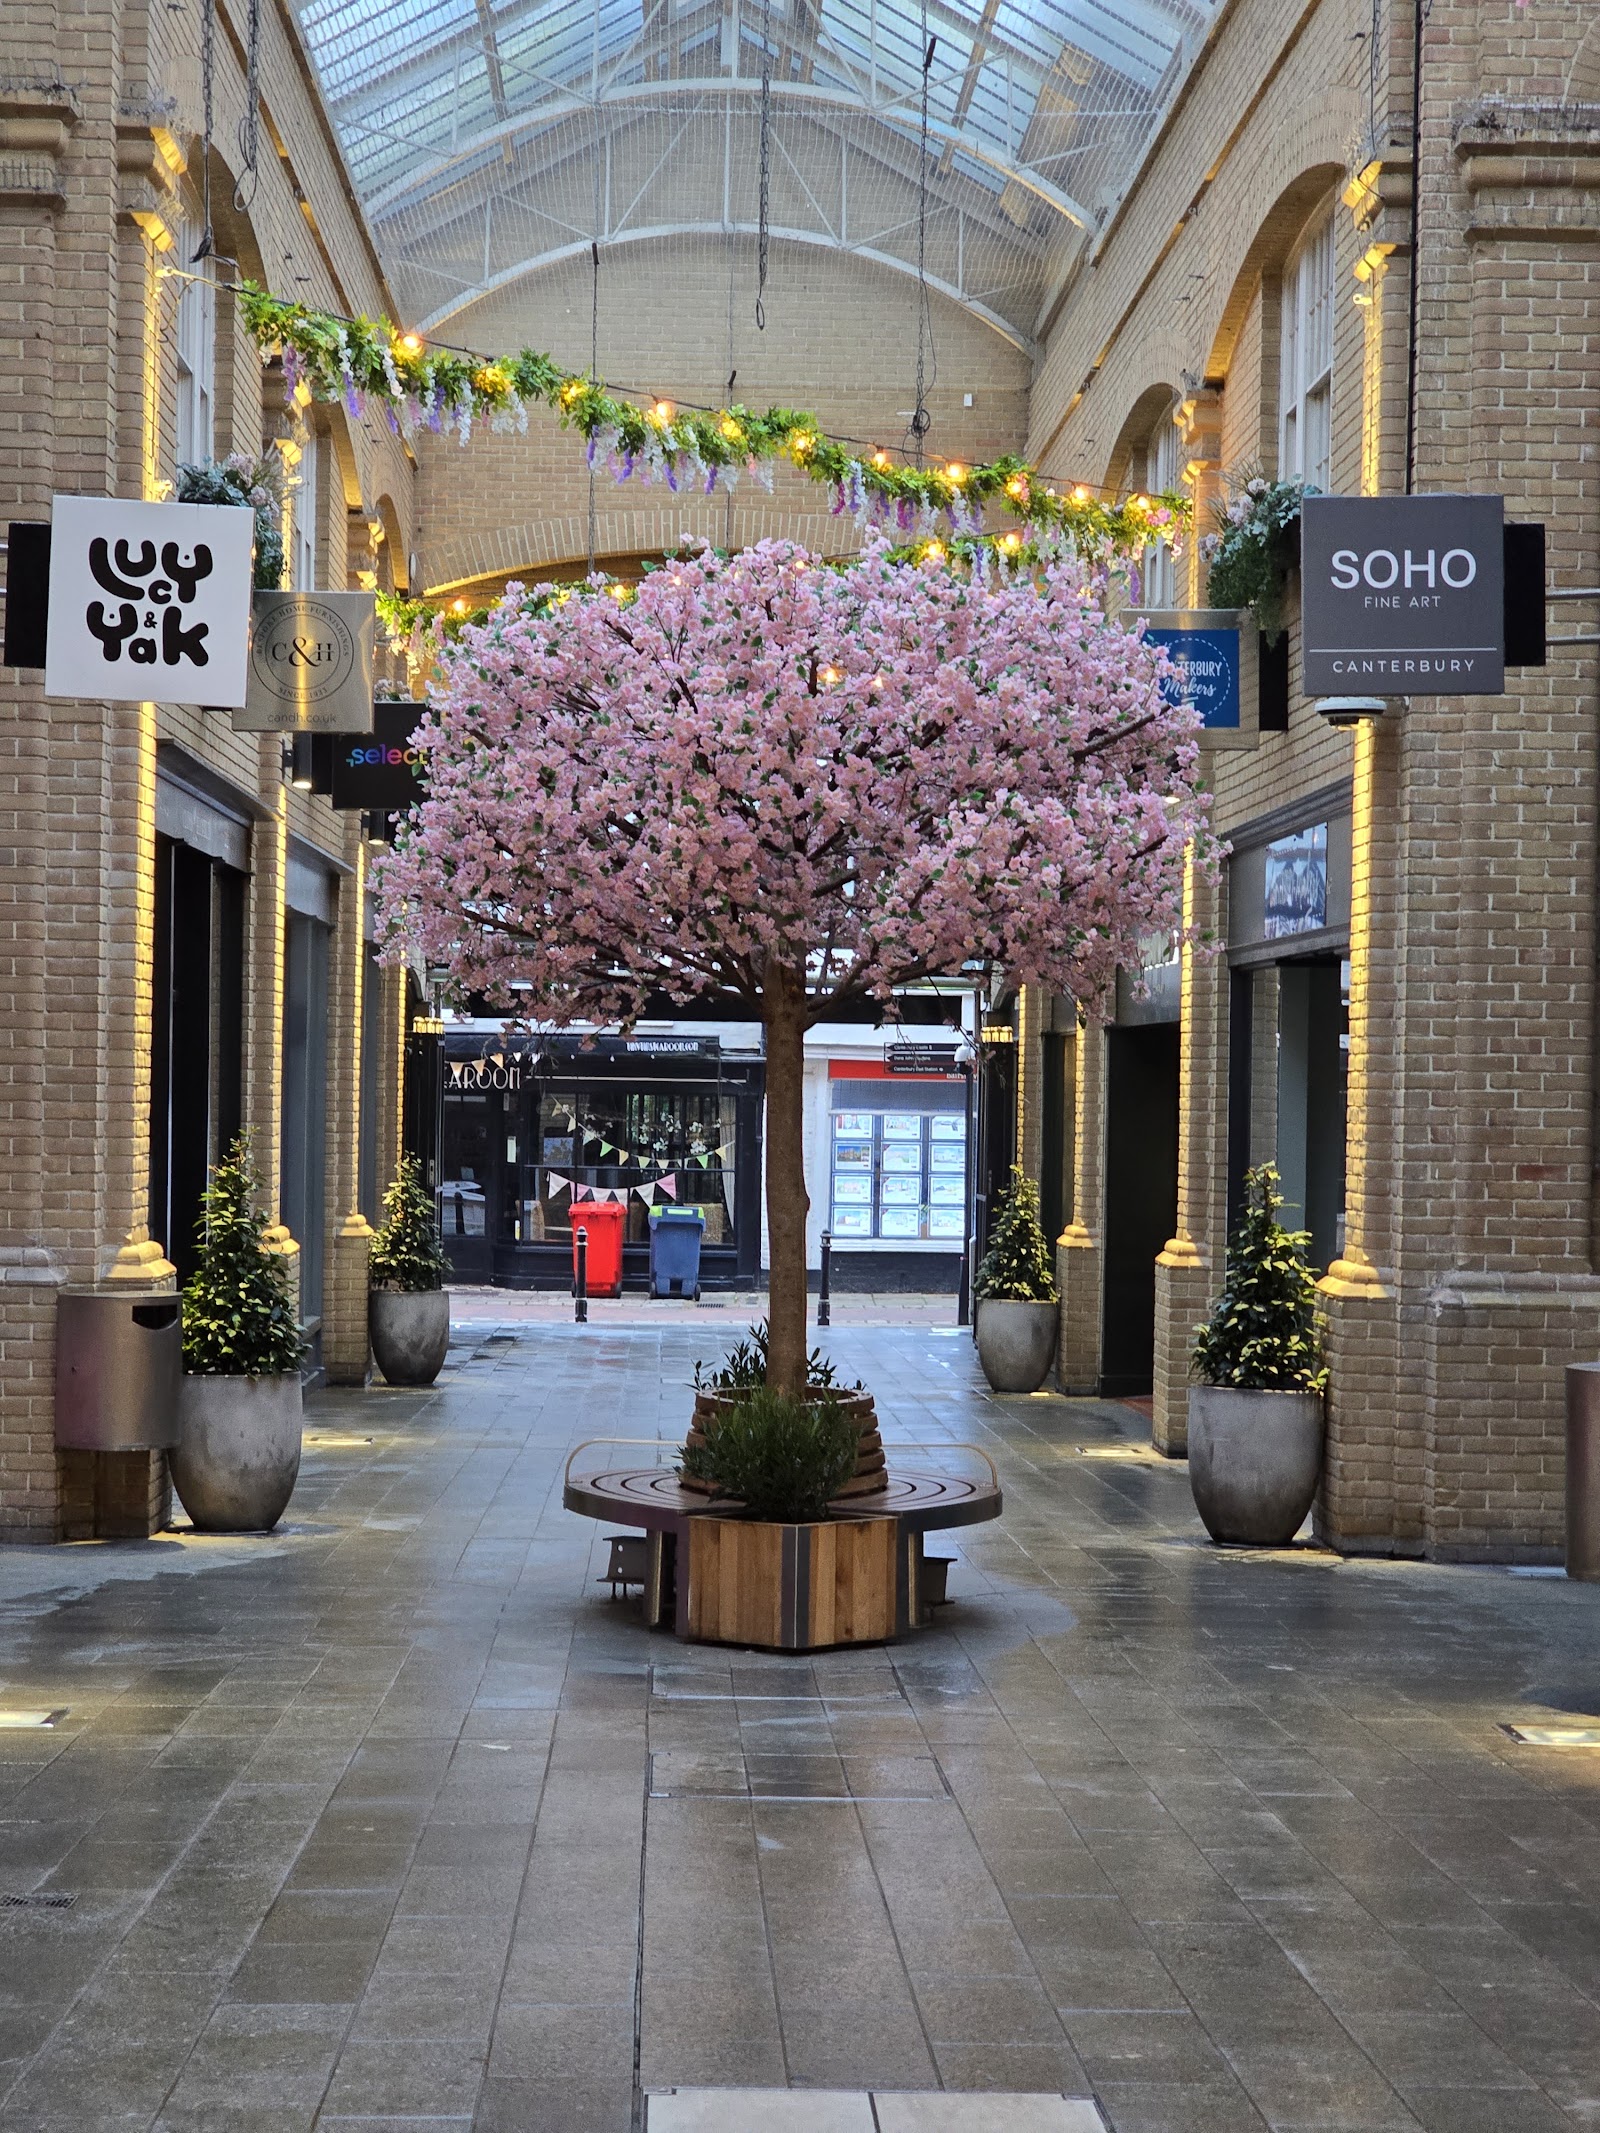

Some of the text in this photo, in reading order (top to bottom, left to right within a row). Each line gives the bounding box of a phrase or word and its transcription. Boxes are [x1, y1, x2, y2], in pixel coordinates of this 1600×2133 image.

[1330, 549, 1476, 589] SOHO
[1364, 596, 1441, 608] FINE ART
[278, 604, 307, 617] HOME
[310, 605, 350, 656] FURNISHINGS
[271, 636, 335, 667] C&H
[1176, 660, 1222, 677] TERBURY
[1332, 659, 1474, 673] CANTERBURY
[279, 687, 305, 699] SINCE
[1164, 676, 1216, 698] Makers
[267, 712, 336, 723] candh.co.uk
